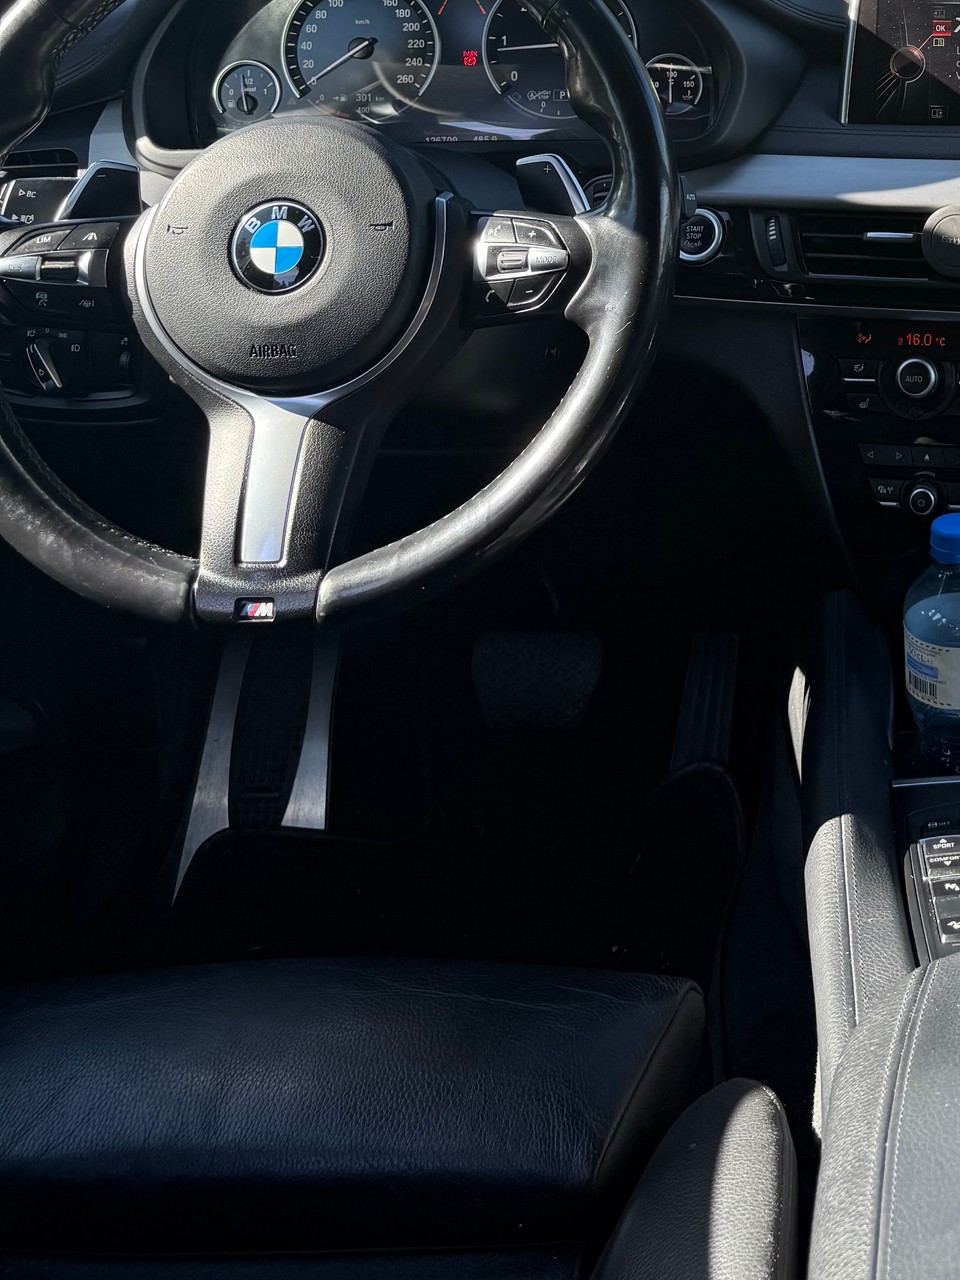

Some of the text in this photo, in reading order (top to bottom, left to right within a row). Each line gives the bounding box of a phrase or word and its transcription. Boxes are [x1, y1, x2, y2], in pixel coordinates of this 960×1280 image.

[328, 0, 344, 7] 100
[315, 10, 327, 19] 80
[395, 9, 411, 18] 180
[305, 24, 318, 33] 60
[402, 23, 420, 31] 200
[407, 40, 425, 48] 220
[502, 35, 507, 46] 1
[300, 41, 313, 50] 40
[302, 60, 314, 68] 20
[405, 58, 422, 66] 240
[397, 75, 414, 83] 260
[511, 71, 518, 81] 0
[356, 93, 372, 102] 301
[906, 333, 933, 346] 16.0
[250, 344, 298, 359] AIRBAG
[905, 375, 923, 383] AUTO
[933, 842, 955, 850] SPORT
